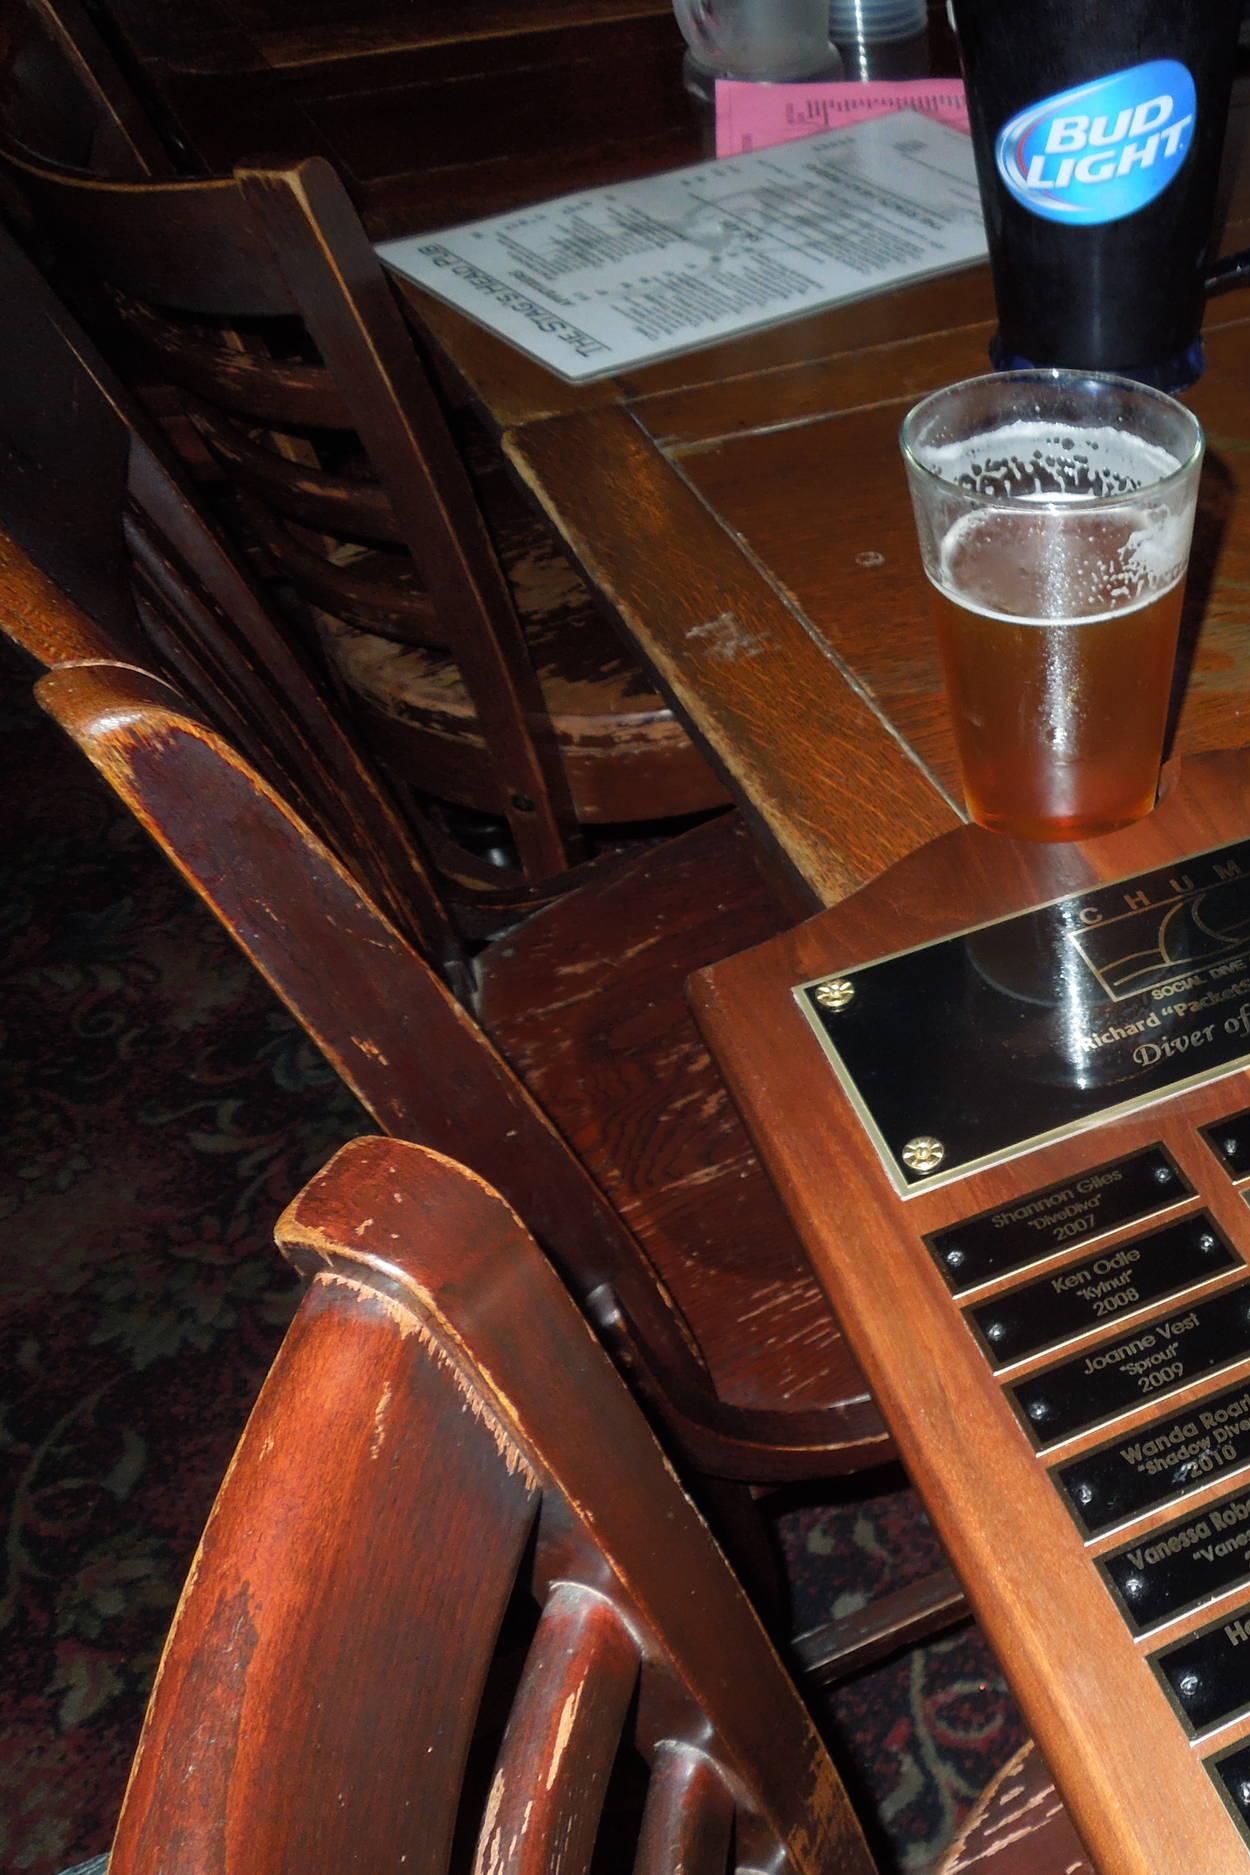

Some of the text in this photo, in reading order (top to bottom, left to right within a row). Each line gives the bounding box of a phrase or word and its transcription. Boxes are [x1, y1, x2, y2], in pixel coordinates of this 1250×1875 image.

[1044, 94, 1174, 155] BUD
[1026, 113, 1192, 190] LIGHT
[1151, 974, 1207, 1001] SOCIAL
[1209, 958, 1249, 980] DIVE
[1081, 1012, 1162, 1052] Richard
[1132, 1022, 1216, 1067] Diver
[991, 1187, 1075, 1229] Shannon
[1052, 1213, 1096, 1241] 2007
[1050, 1270, 1092, 1294] Ken
[1092, 1286, 1140, 1318] 2008
[1083, 1311, 1201, 1375] Joanne Vest
[1137, 1361, 1185, 1394] 2009
[1119, 1421, 1199, 1465] Wanda
[1186, 1443, 1238, 1480] 2010
[1126, 1520, 1212, 1571] Vanessa
